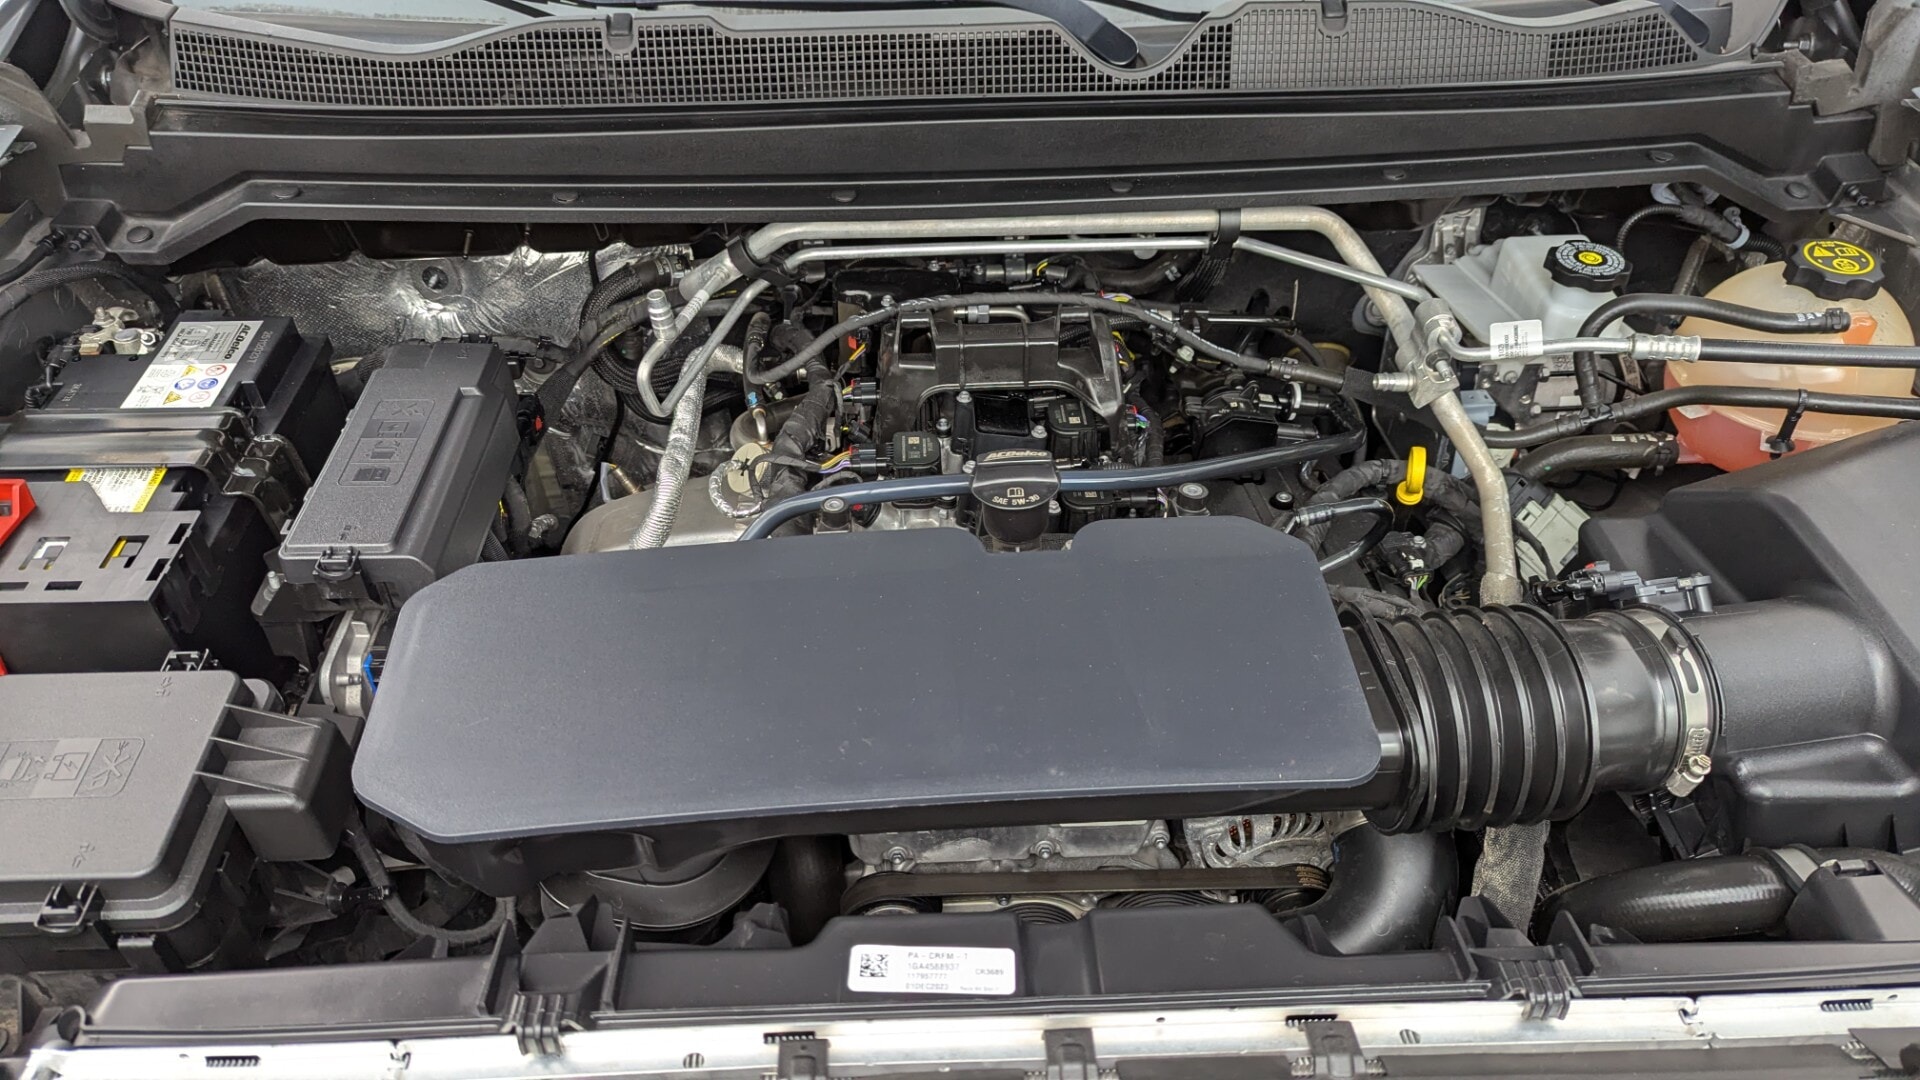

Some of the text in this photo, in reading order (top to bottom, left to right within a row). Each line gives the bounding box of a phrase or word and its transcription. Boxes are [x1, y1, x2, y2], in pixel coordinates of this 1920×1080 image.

[224, 324, 251, 360] ACDelco
[984, 450, 1047, 461] ACDelco
[992, 493, 1041, 506] SAE 5W-30
[908, 951, 919, 959] PA
